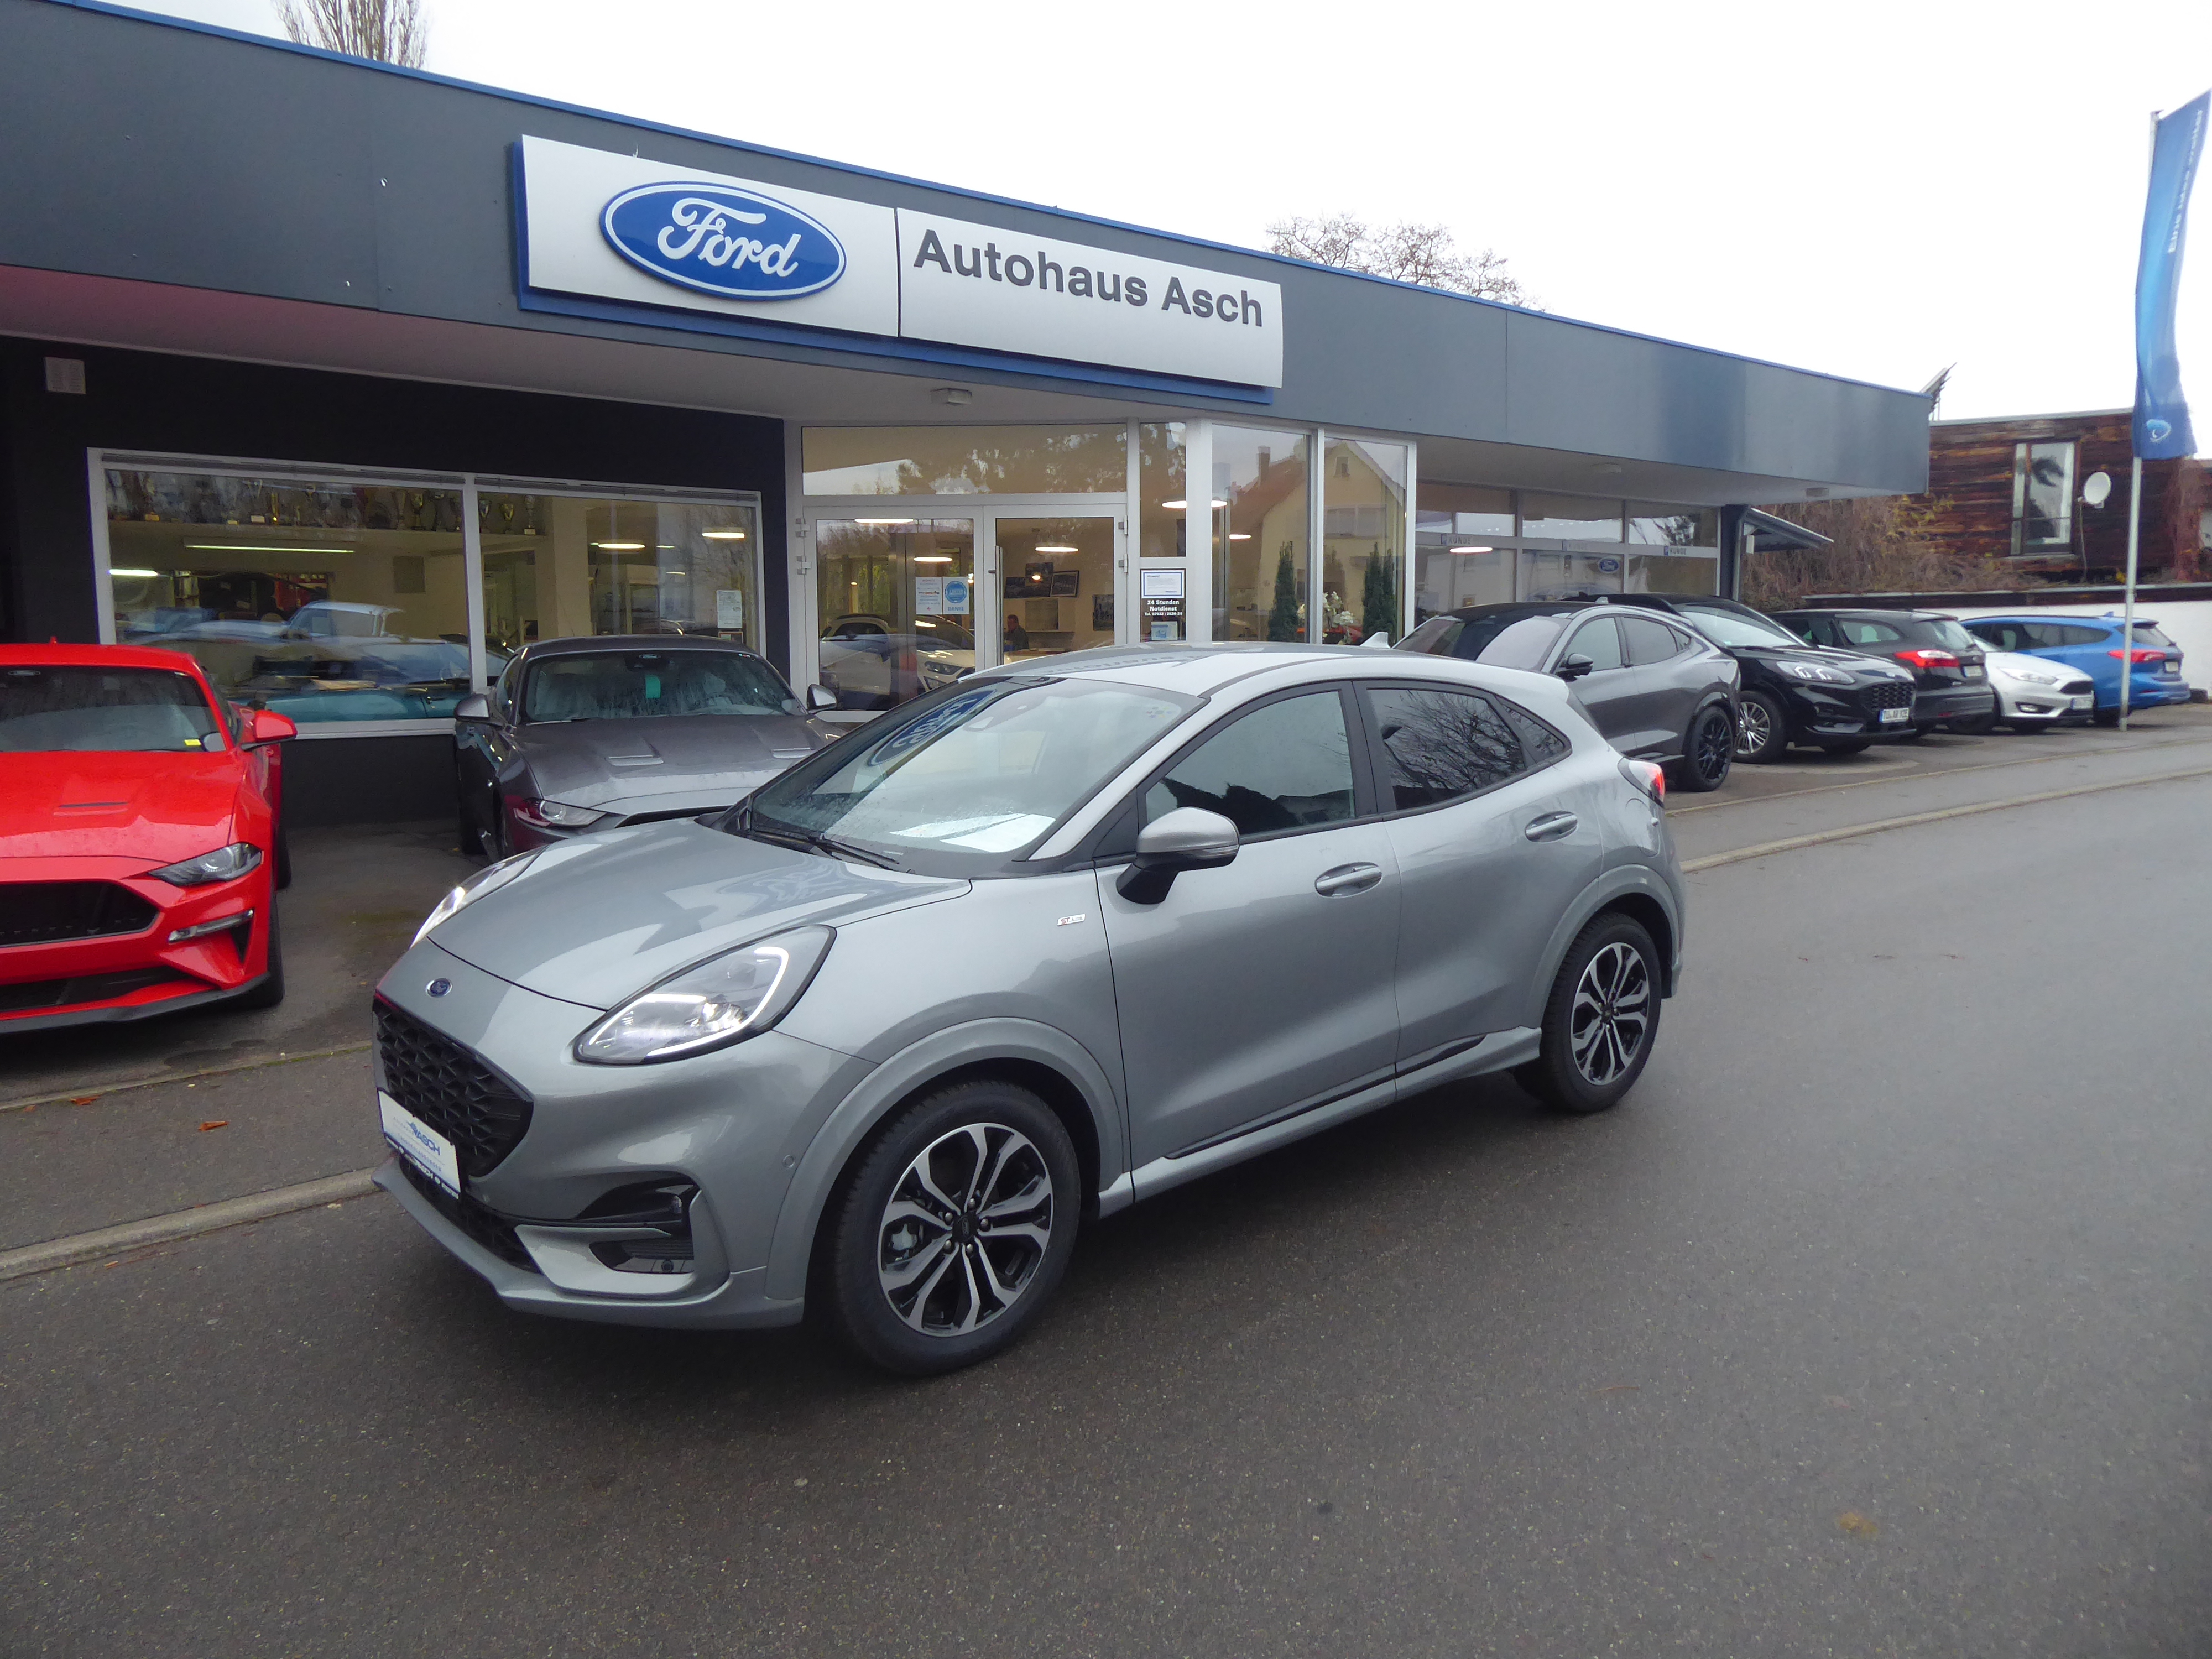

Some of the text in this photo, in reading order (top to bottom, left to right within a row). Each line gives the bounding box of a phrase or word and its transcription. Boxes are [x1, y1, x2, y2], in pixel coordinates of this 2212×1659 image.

[656, 197, 802, 278] Ford
[913, 229, 1263, 327] Autohaus Asch
